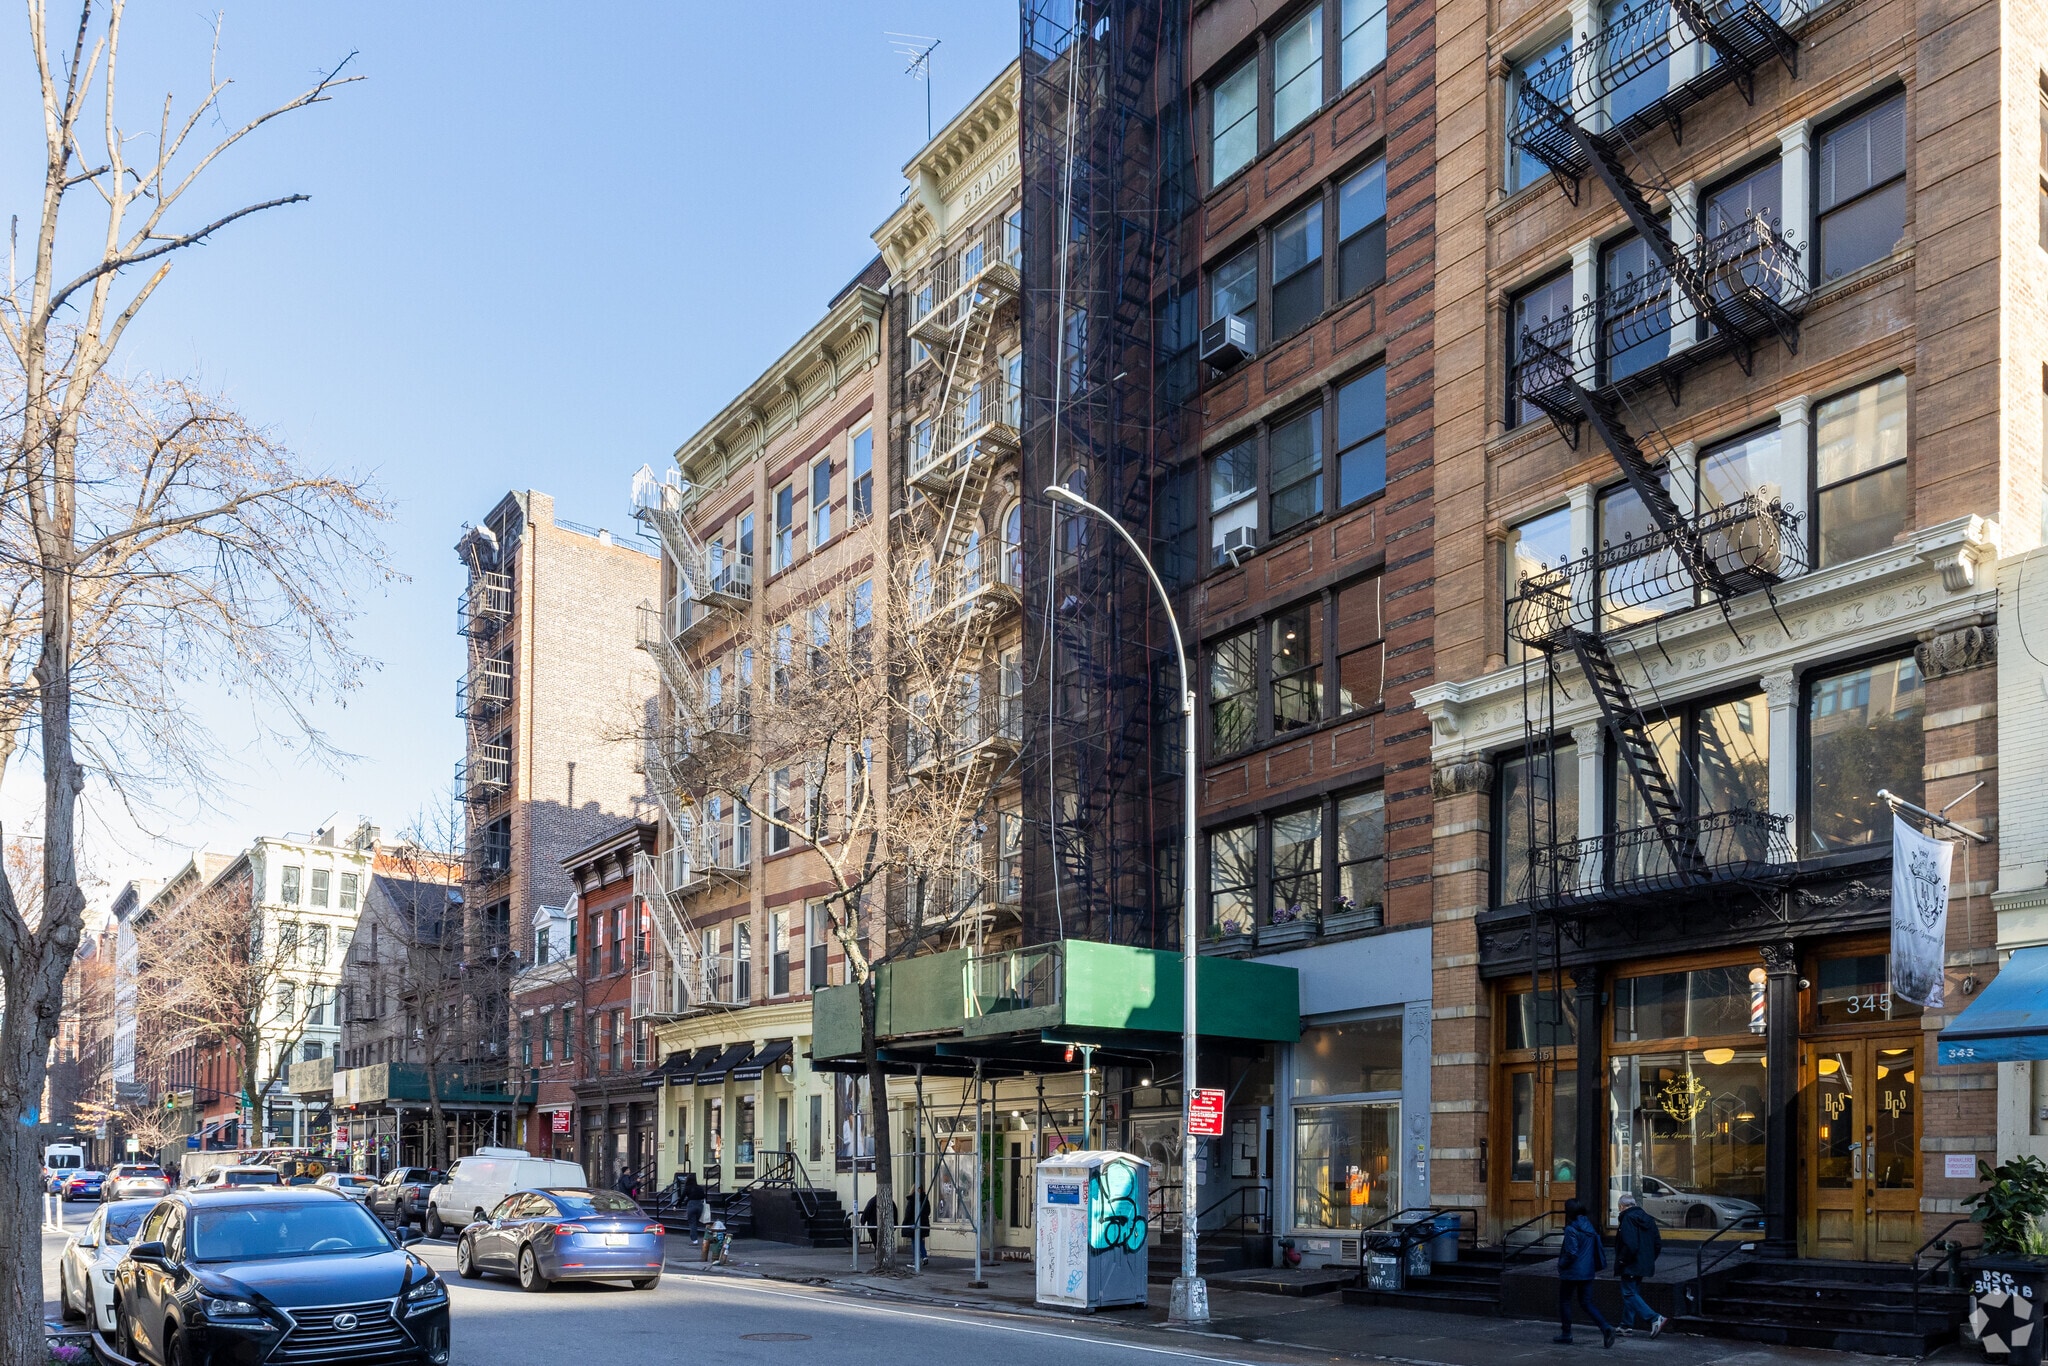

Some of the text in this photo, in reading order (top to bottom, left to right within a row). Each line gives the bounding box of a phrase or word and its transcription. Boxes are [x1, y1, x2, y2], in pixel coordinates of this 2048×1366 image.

[963, 150, 1016, 208] GRAND
[1846, 993, 1893, 1014] 345
[1948, 1048, 1975, 1058] 343
[1982, 1269, 2015, 1285] BSG
[1974, 1280, 2001, 1296] 343
